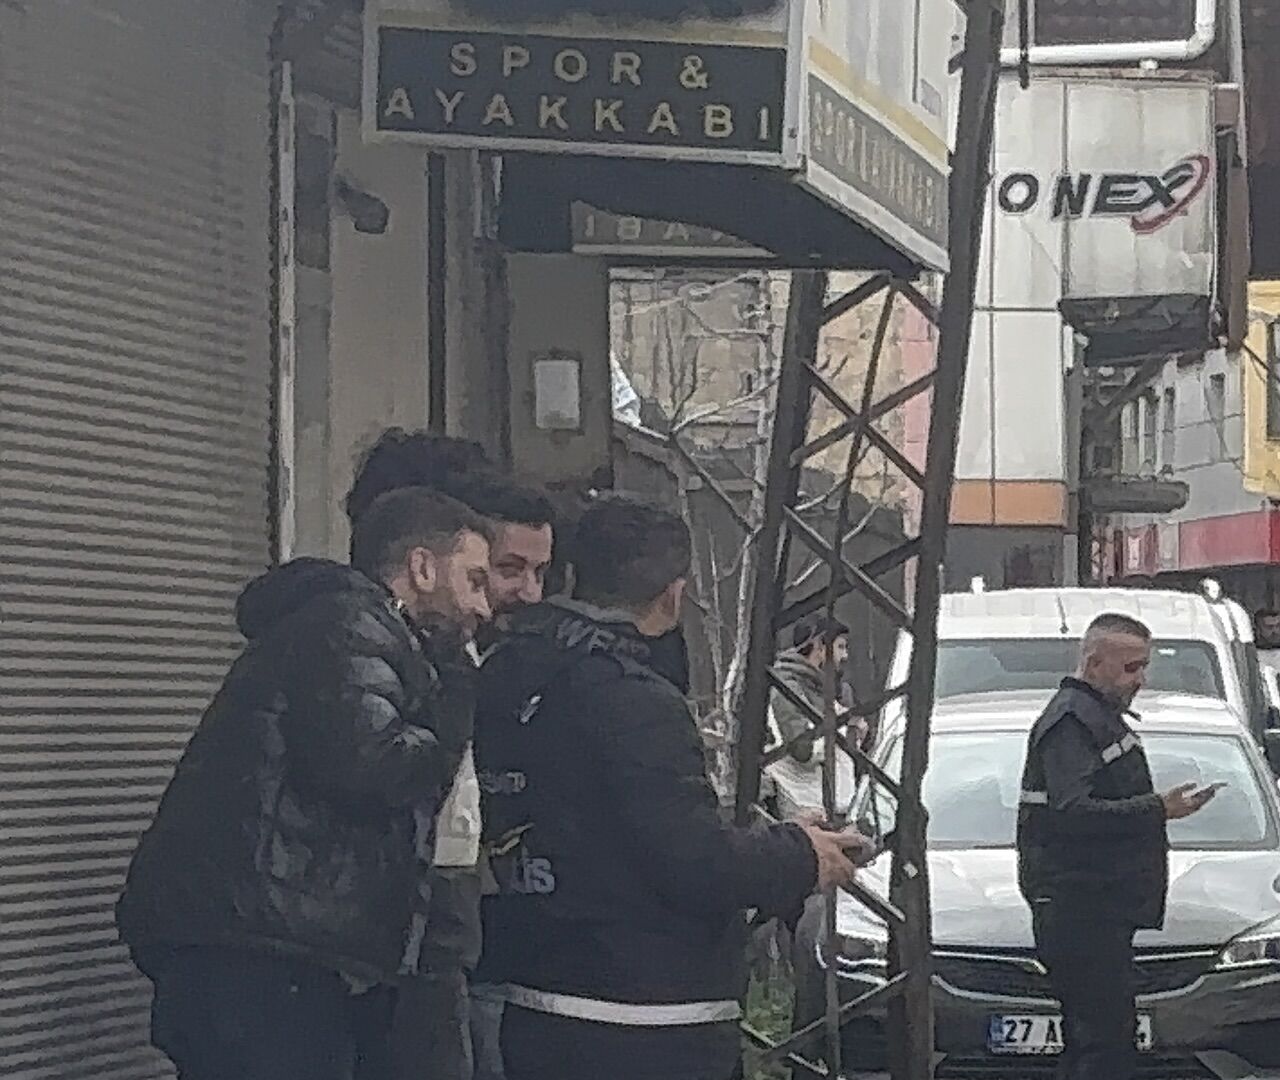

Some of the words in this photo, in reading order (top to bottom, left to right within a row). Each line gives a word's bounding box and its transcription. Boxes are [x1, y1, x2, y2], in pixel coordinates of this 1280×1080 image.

[450, 42, 641, 87] SPOR
[679, 55, 708, 89] &
[384, 87, 770, 141] AYAKKABI
[998, 162, 1195, 220] ONEX
[1004, 1019, 1032, 1043] 27
